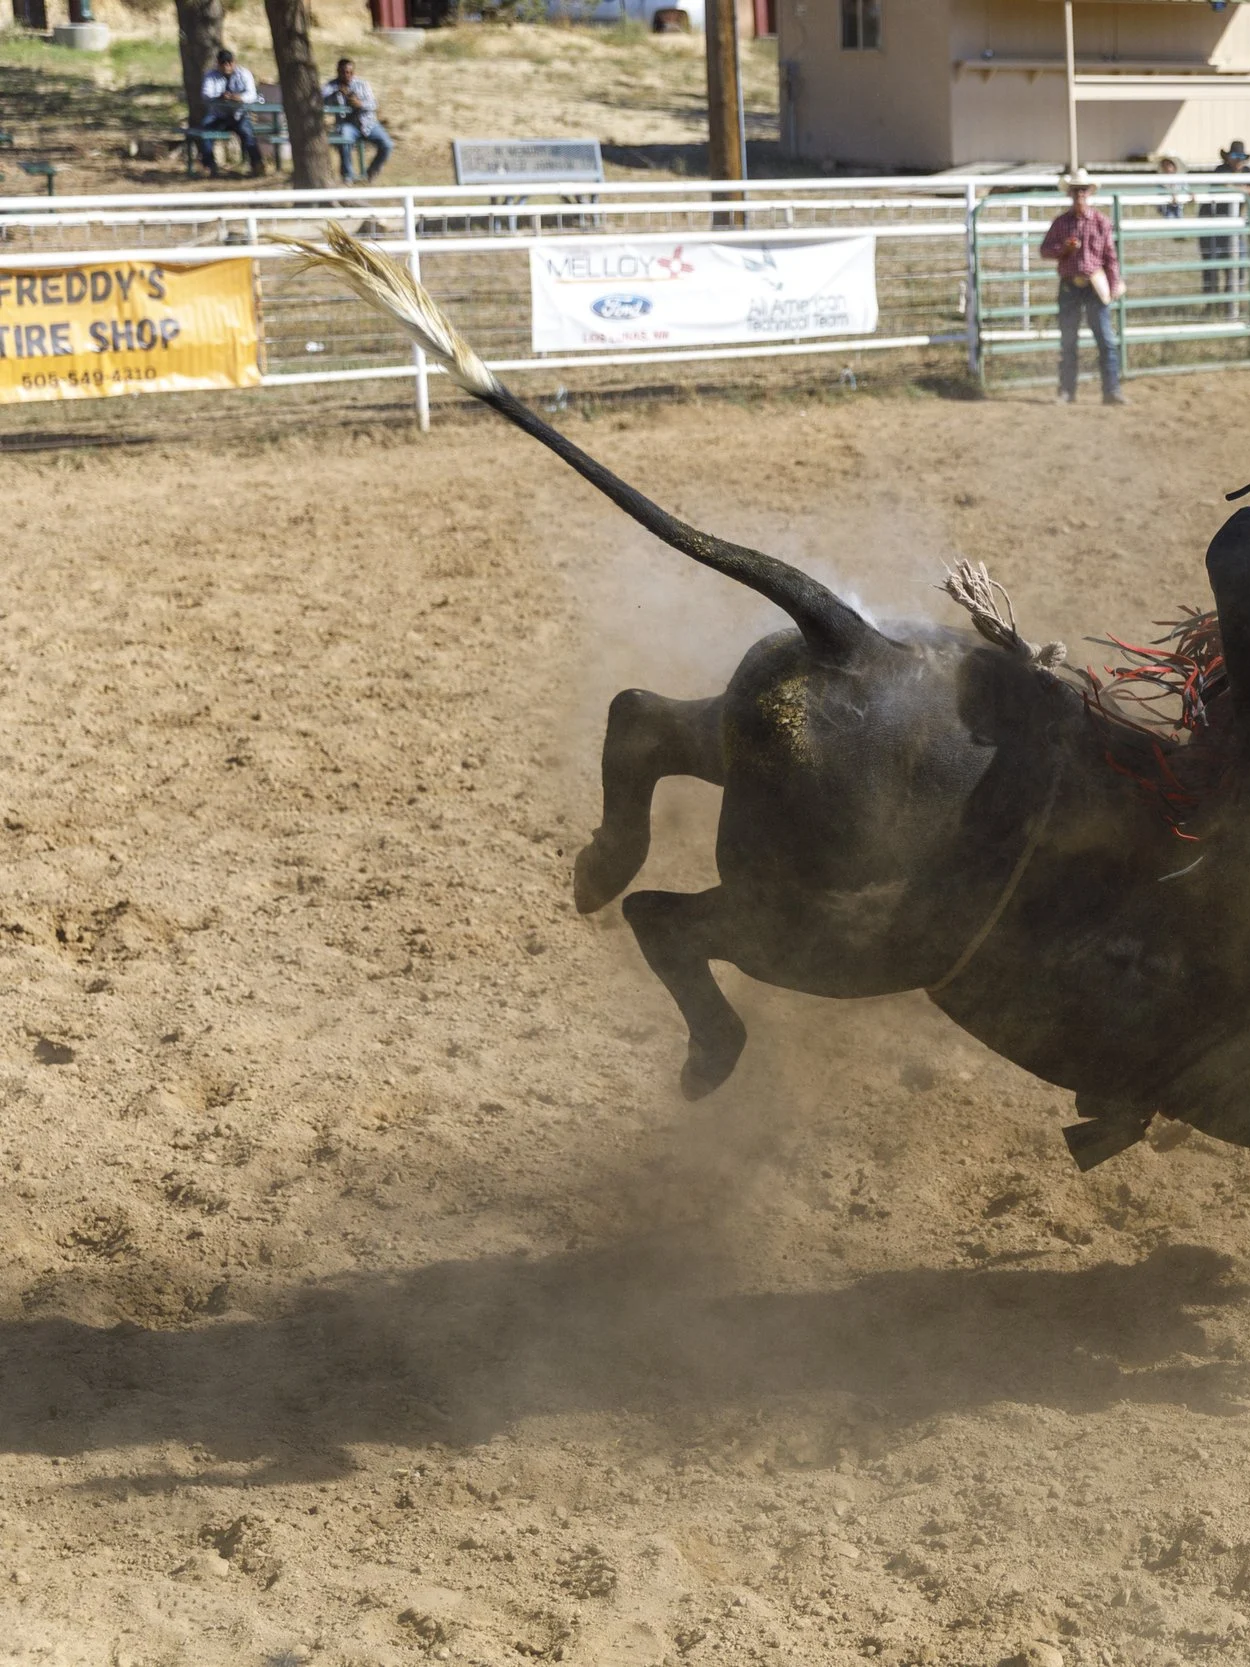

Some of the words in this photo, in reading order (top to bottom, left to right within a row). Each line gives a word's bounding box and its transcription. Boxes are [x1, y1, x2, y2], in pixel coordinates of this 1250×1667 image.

[547, 254, 656, 277] MELLOY
[0, 268, 166, 307] FREDDY'S
[0, 323, 73, 358] TIRE
[89, 318, 180, 353] SHOP
